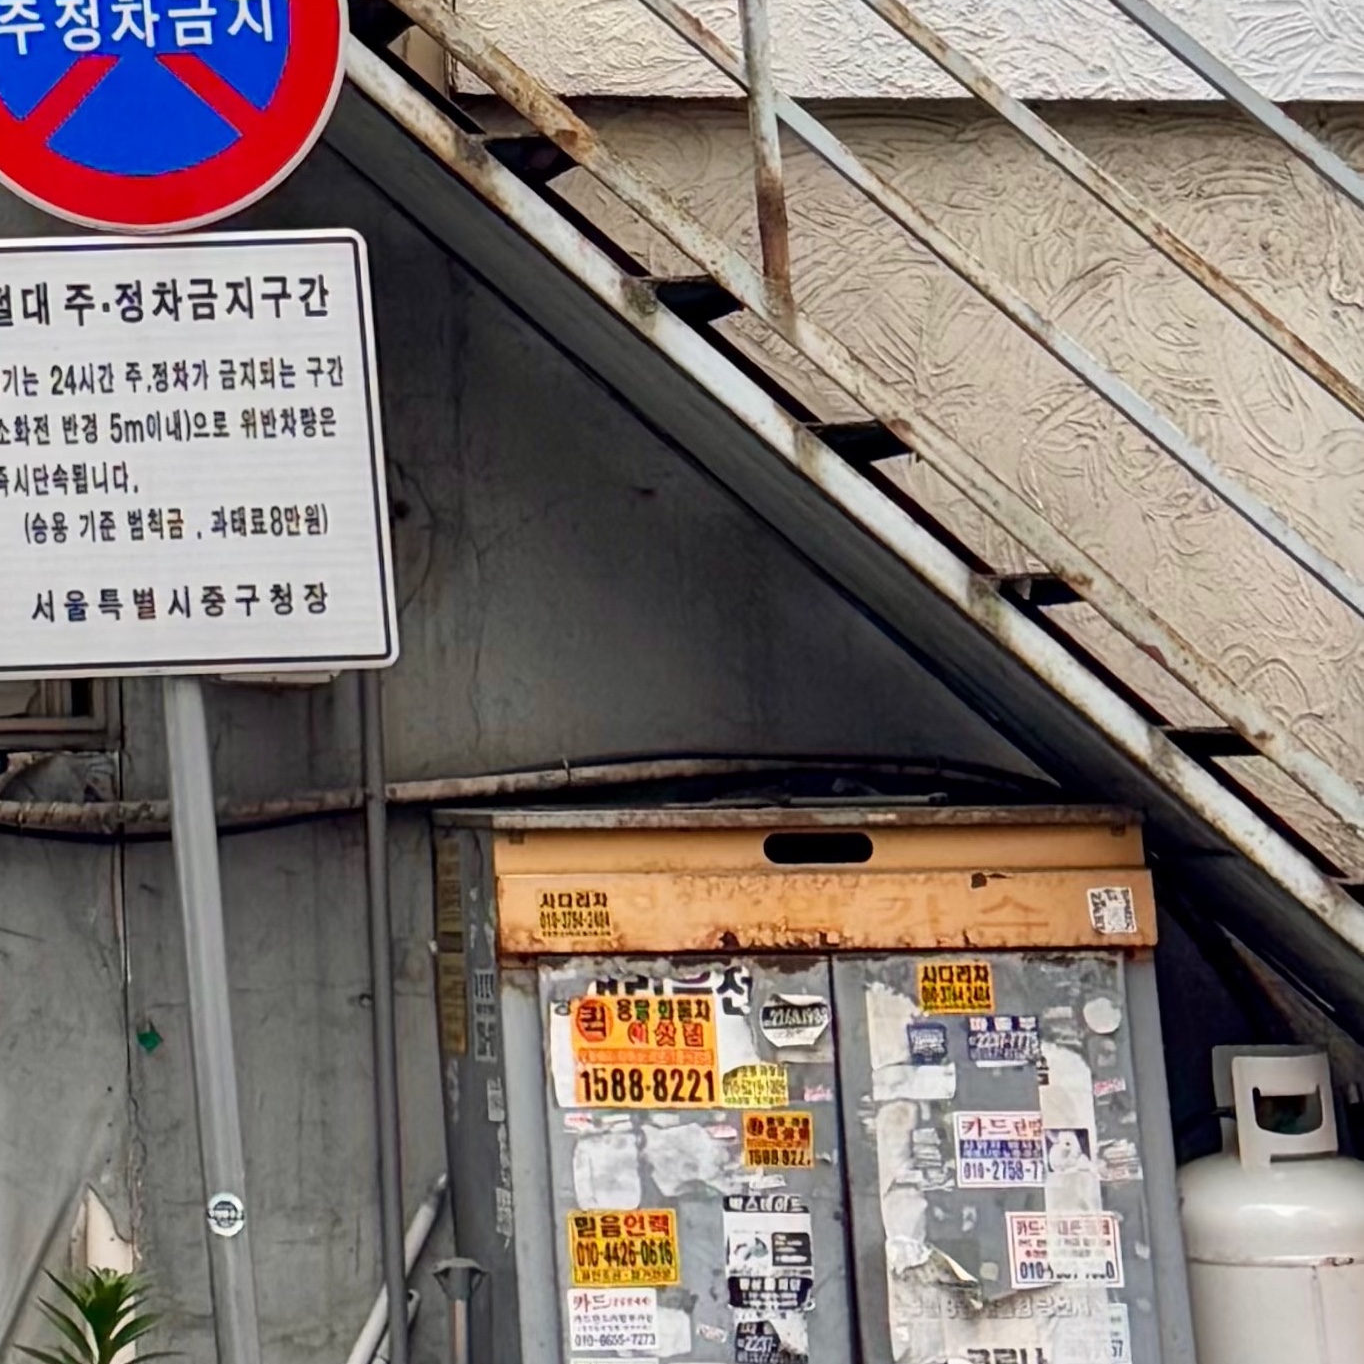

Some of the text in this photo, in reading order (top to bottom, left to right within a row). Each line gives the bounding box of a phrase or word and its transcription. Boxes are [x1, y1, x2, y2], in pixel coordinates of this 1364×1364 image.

[50, 362, 115, 396] 24시간
[218, 358, 297, 391] 금지되는
[306, 355, 345, 388] 구간
[62, 413, 99, 445] 반경
[110, 409, 231, 444] 5m이내)으로
[240, 406, 337, 439] 위반차량은
[24, 511, 69, 544] (승용
[79, 511, 117, 542] 기준
[127, 508, 186, 540] 범칙금
[210, 503, 330, 538] 과태료8만원)
[31, 582, 329, 623] 서울특별시중구청장
[960, 1117, 1012, 1138] 카드
[574, 1293, 610, 1313] 카드
